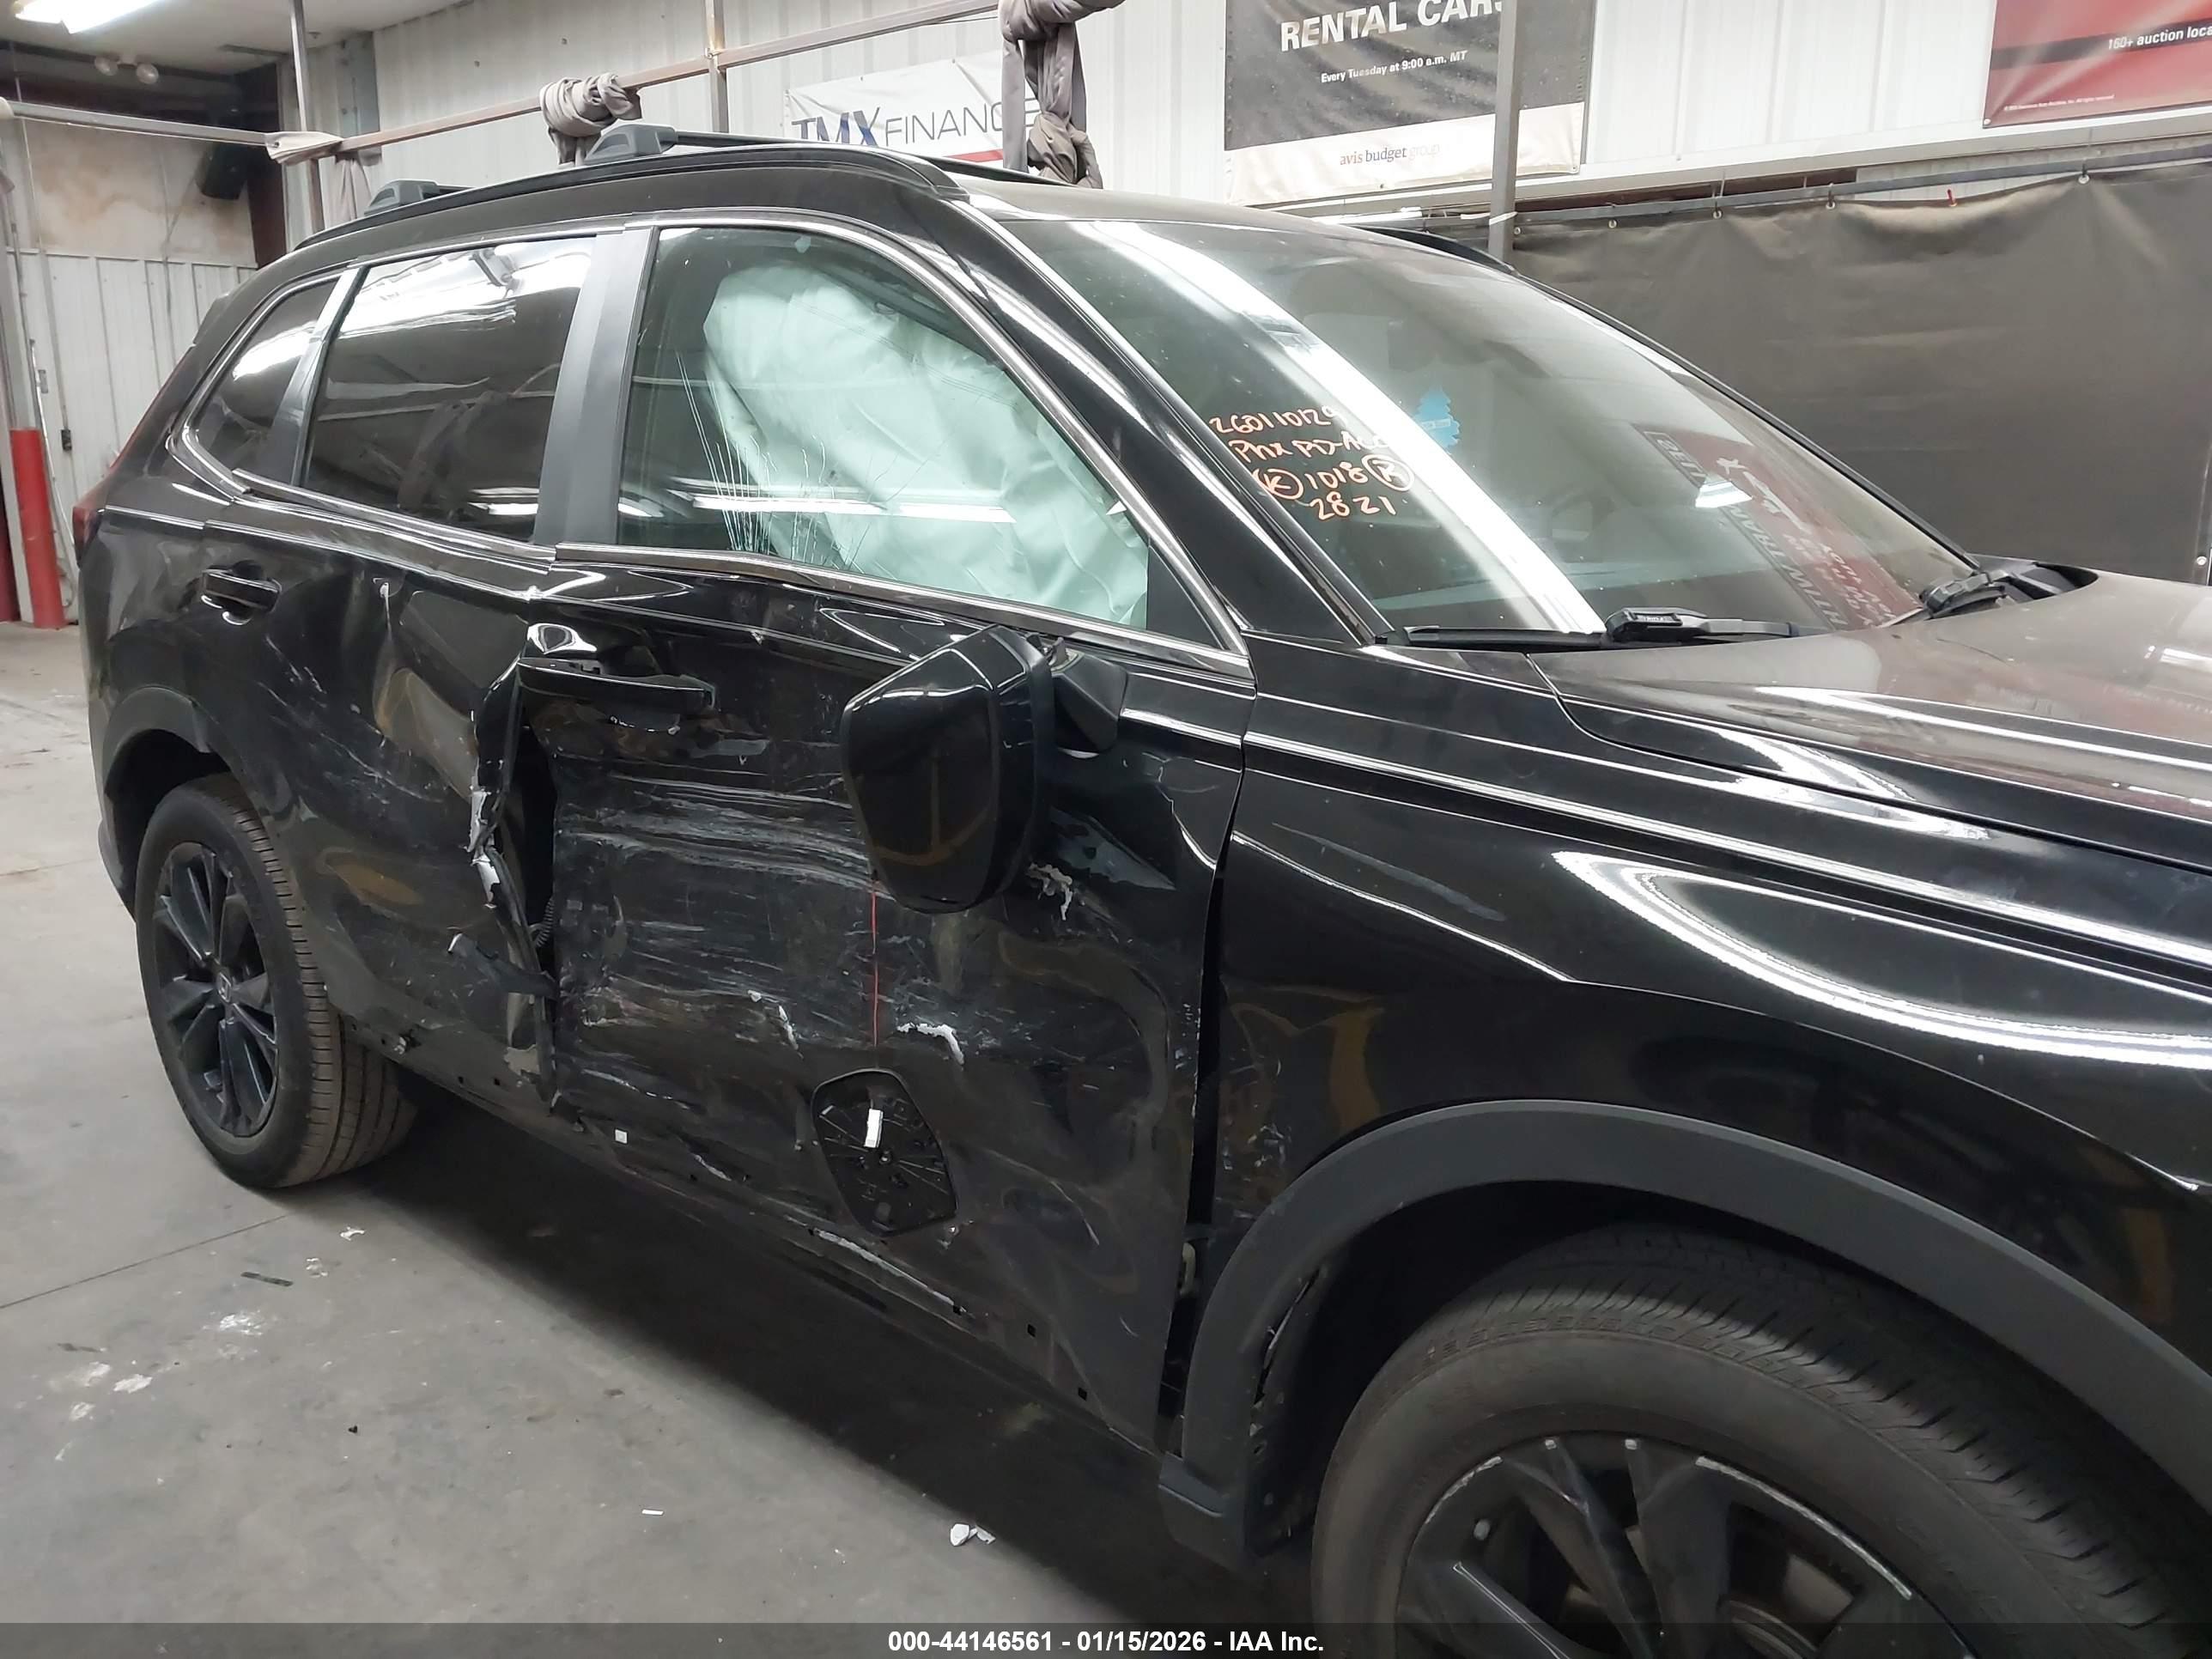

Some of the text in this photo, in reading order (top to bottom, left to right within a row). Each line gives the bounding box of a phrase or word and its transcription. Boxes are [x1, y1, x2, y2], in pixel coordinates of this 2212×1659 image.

[1280, 0, 1503, 52] RENTAL CAR
[2108, 36, 2134, 50] 160+
[2136, 29, 2184, 46] auction
[1321, 50, 1468, 83] Every Tuesday at 9:00 a.m. MT
[1340, 151, 1363, 166] avis
[1364, 147, 1407, 163] budget
[1304, 460, 1369, 489] 1018
